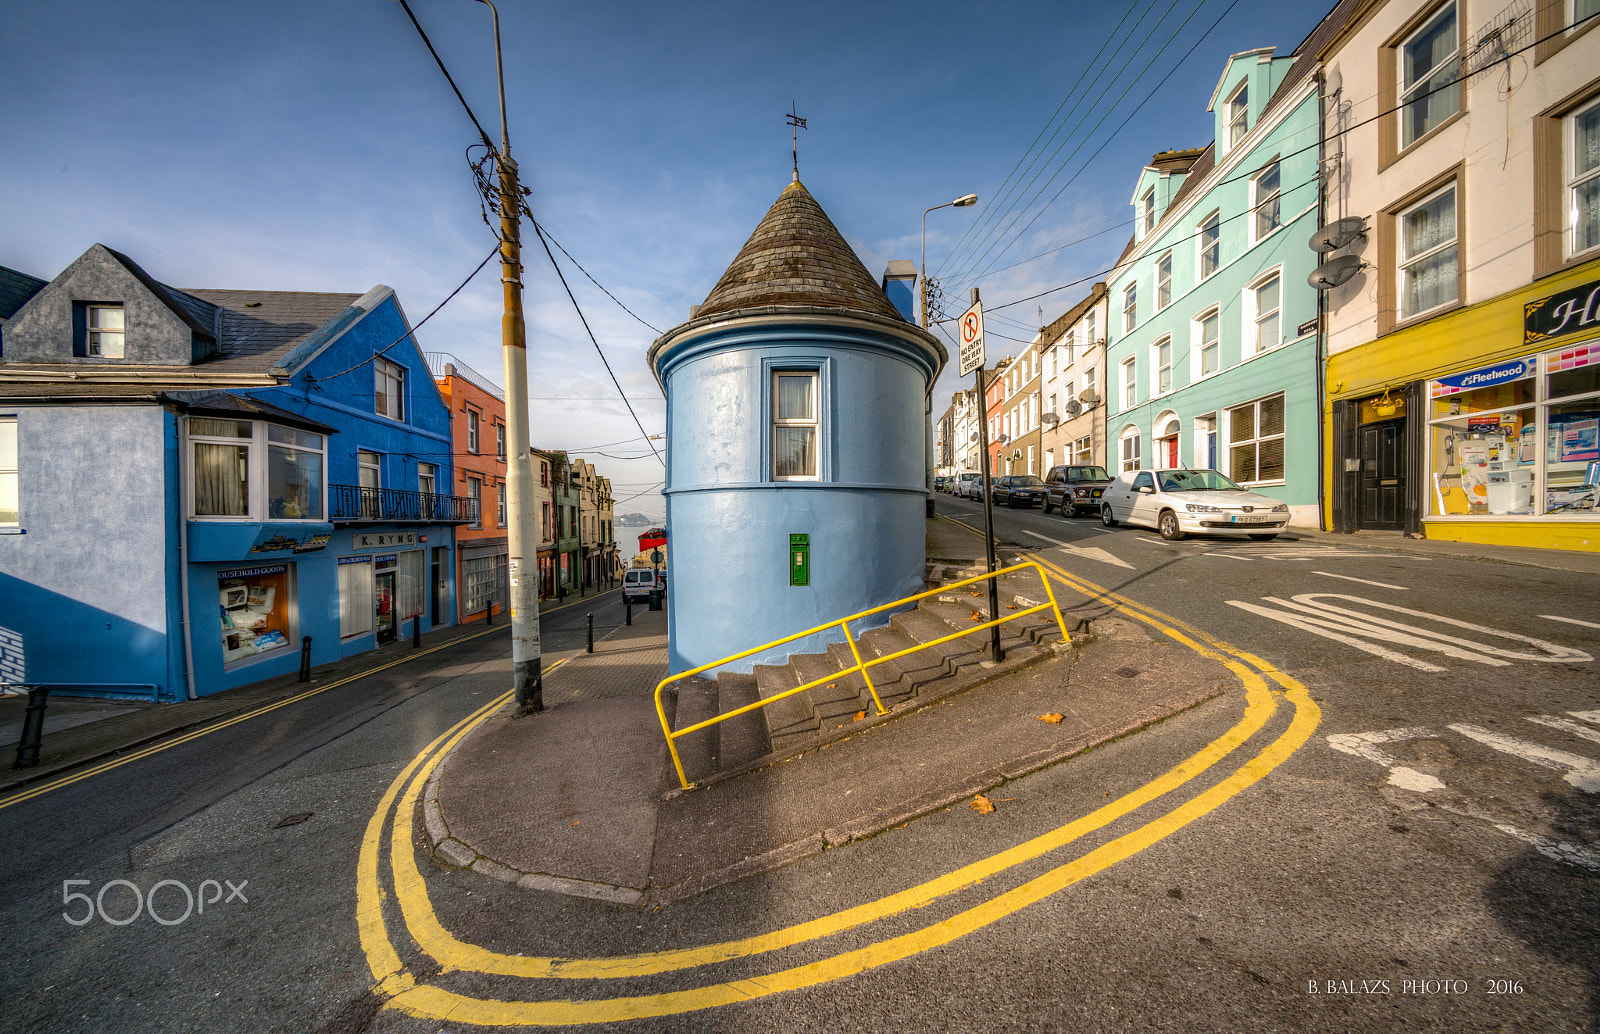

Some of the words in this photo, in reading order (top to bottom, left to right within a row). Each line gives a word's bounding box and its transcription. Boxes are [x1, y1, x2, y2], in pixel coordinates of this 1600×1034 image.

[1547, 285, 1600, 335] H
[961, 347, 967, 356] NO
[968, 338, 982, 352] ENTRY
[962, 353, 971, 364] ONE
[971, 346, 982, 358] WAY
[964, 357, 980, 371] STREET
[1473, 364, 1522, 383] Fleetwood
[362, 536, 373, 546] K.
[261, 565, 285, 574] GOODS
